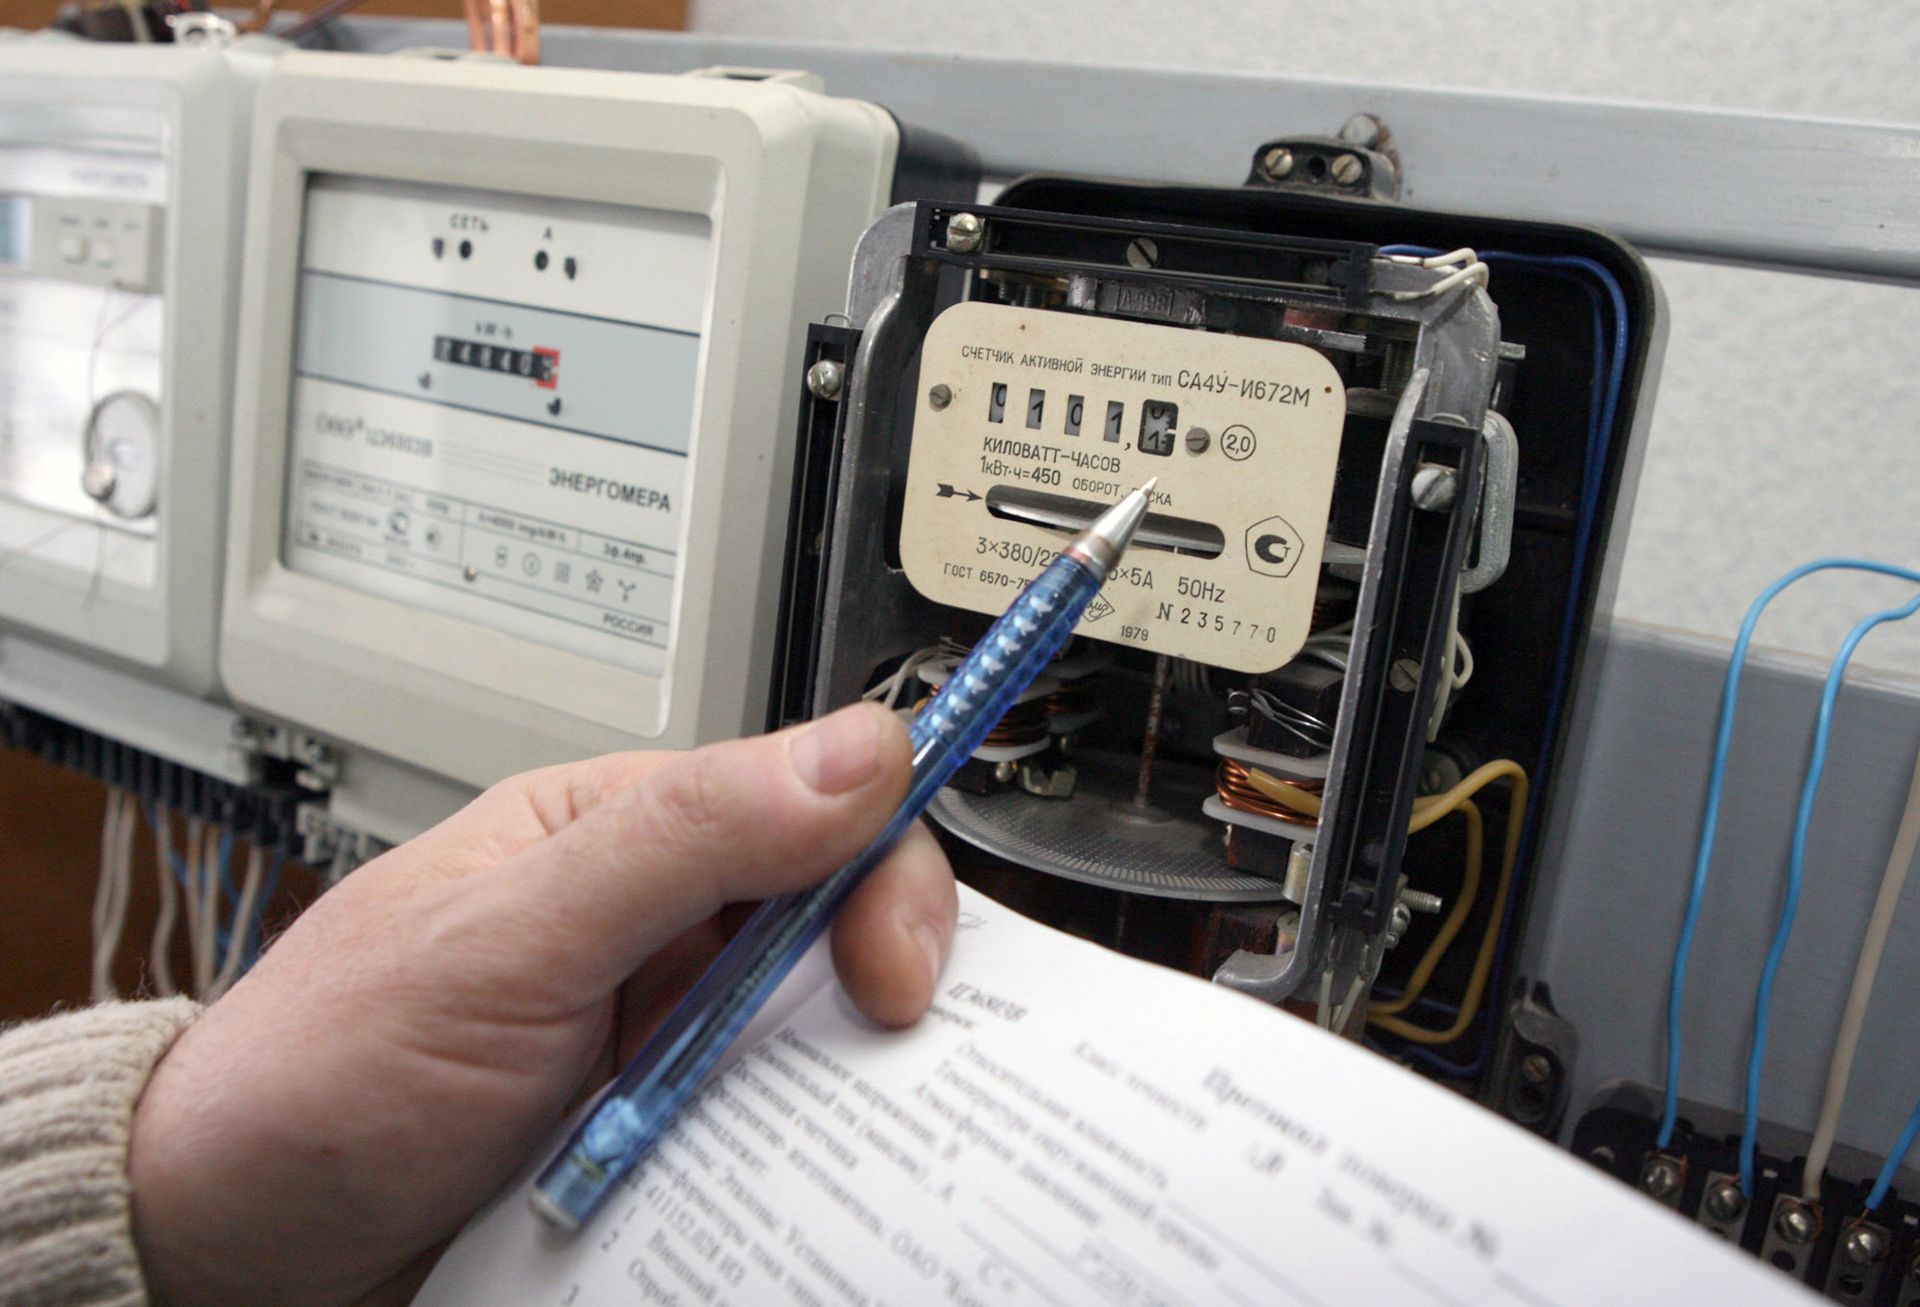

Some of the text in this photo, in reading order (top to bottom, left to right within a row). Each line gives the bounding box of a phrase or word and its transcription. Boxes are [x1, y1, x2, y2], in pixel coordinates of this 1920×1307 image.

[961, 345, 1014, 365] СЧЕТЧИК
[1020, 354, 1083, 374] АКТИВНОЙ
[1090, 363, 1147, 383] ЭНЕРГИИ
[982, 436, 1122, 474] КИЛОВАТТ-ЧАСОВ
[1226, 433, 1251, 455] 2,0
[549, 467, 671, 513] ЭНЕРГОМЕРА
[1072, 477, 1125, 499] ОБОРОТ.
[944, 562, 972, 579] ГОСТ
[1177, 575, 1226, 604] 50Hz
[1120, 624, 1150, 642] 1979
